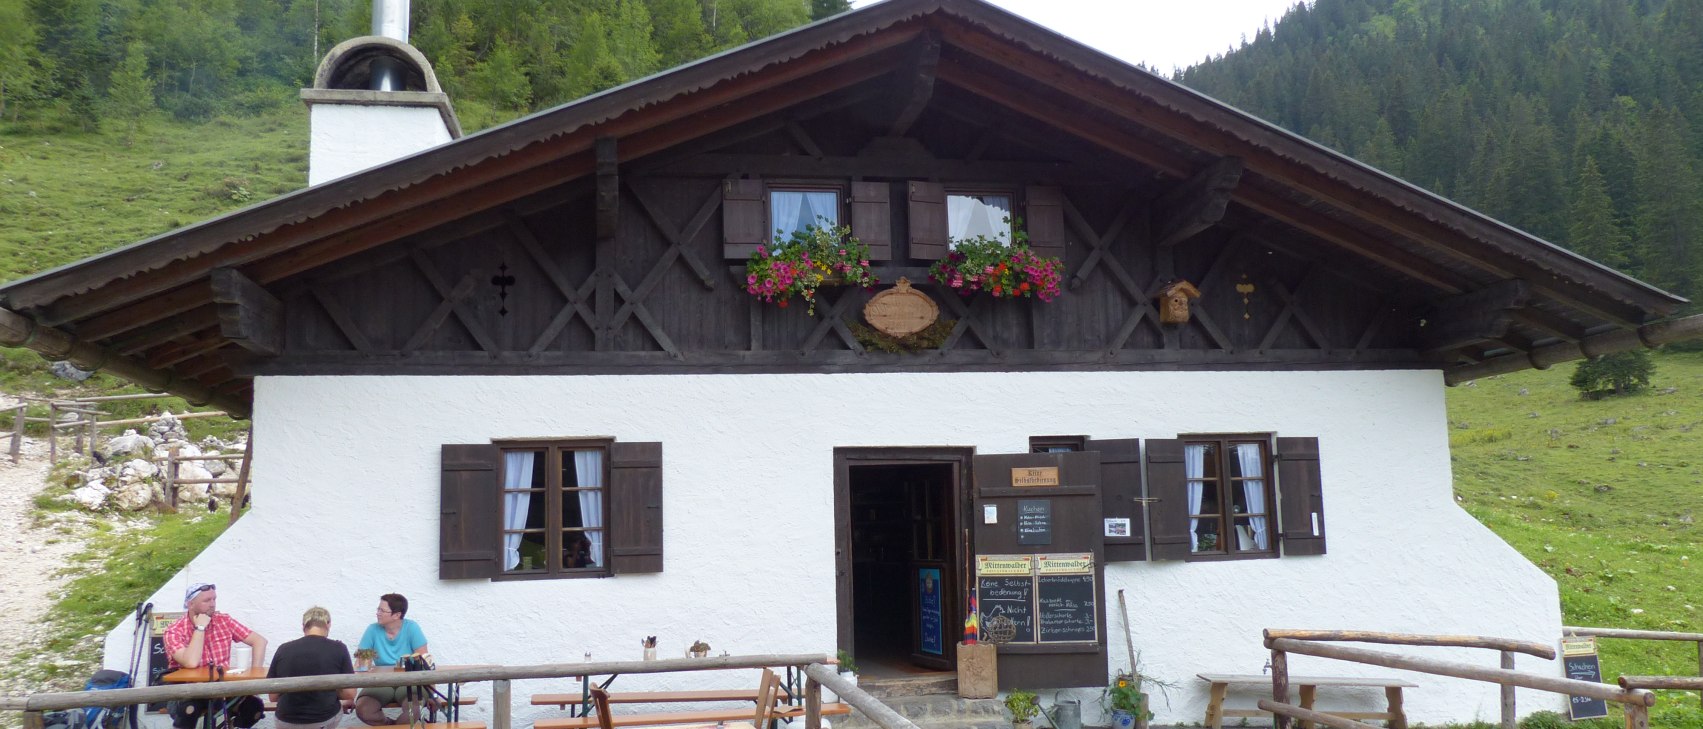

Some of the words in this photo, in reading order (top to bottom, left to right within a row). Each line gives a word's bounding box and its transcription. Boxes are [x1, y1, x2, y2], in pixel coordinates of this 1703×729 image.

[984, 561, 1027, 569] Mittenwalder
[1043, 560, 1087, 569] Mittenwalder
[1007, 604, 1027, 614] Nicht
